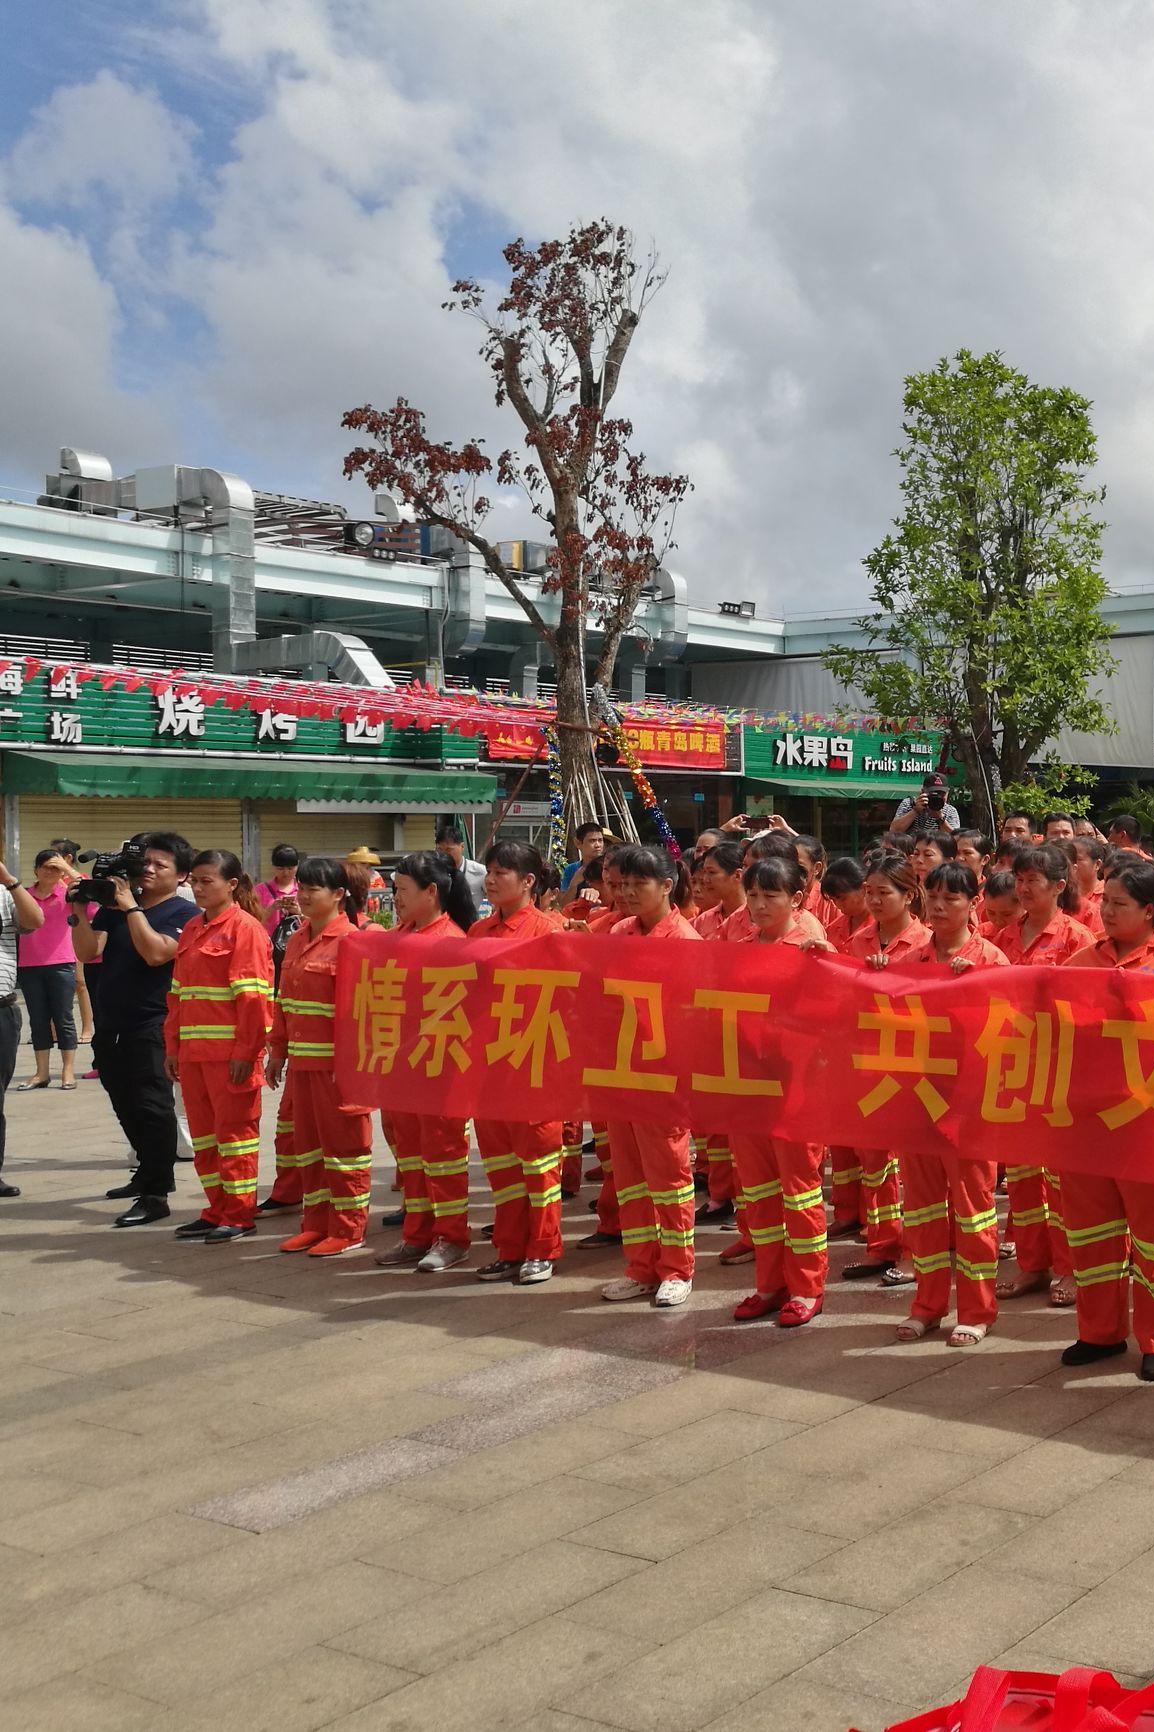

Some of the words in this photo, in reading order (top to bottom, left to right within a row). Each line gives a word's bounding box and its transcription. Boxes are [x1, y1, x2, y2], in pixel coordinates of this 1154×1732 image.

[864, 756, 897, 772] Fruits
[901, 758, 933, 772] Island
[353, 958, 784, 1096] 情系环卫工
